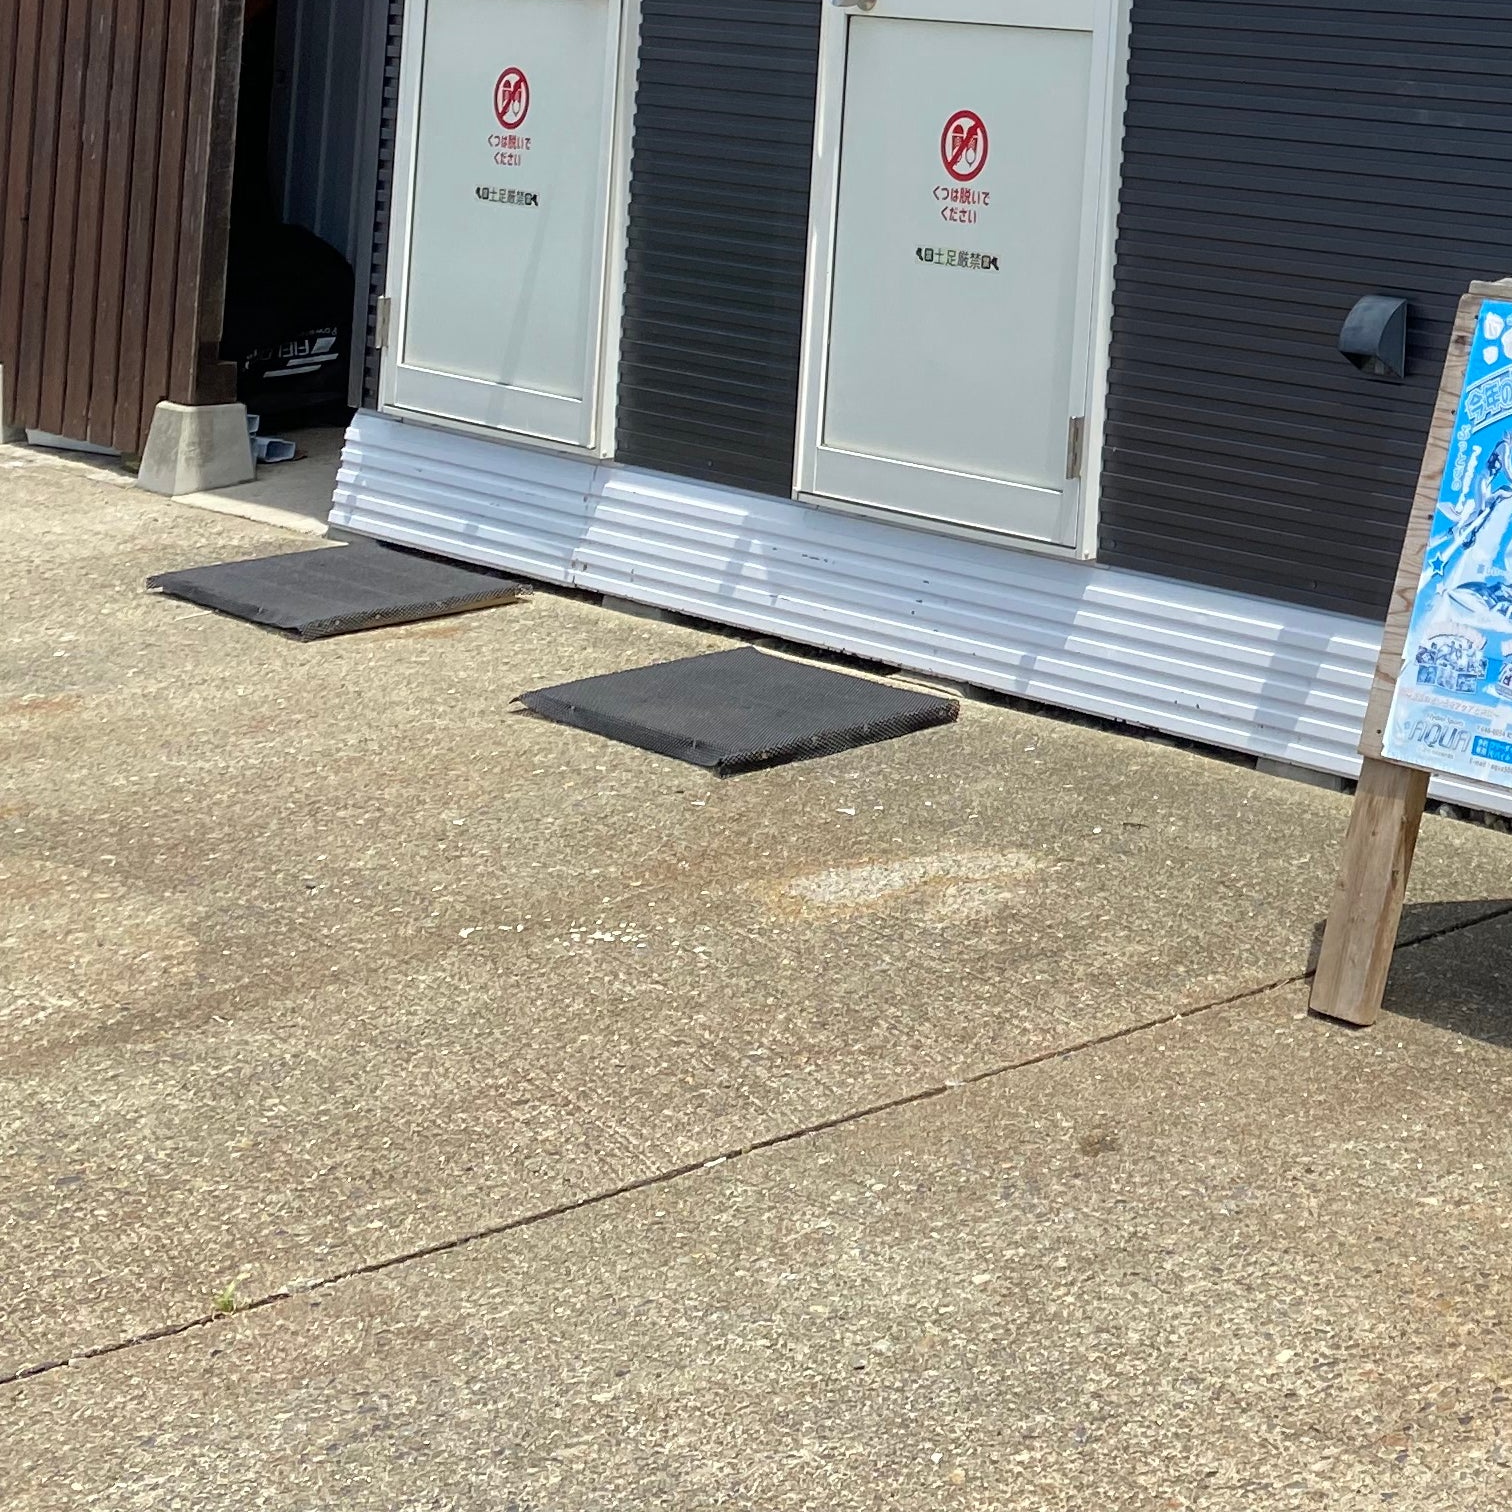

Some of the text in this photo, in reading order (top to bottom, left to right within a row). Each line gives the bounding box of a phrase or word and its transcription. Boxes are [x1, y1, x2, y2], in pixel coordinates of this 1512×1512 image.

[493, 152, 521, 166] ください
[933, 186, 991, 206] くつは脱いで
[941, 206, 977, 224] ください
[933, 248, 981, 270] 土足厳禁
[1409, 719, 1472, 752] AQUA
